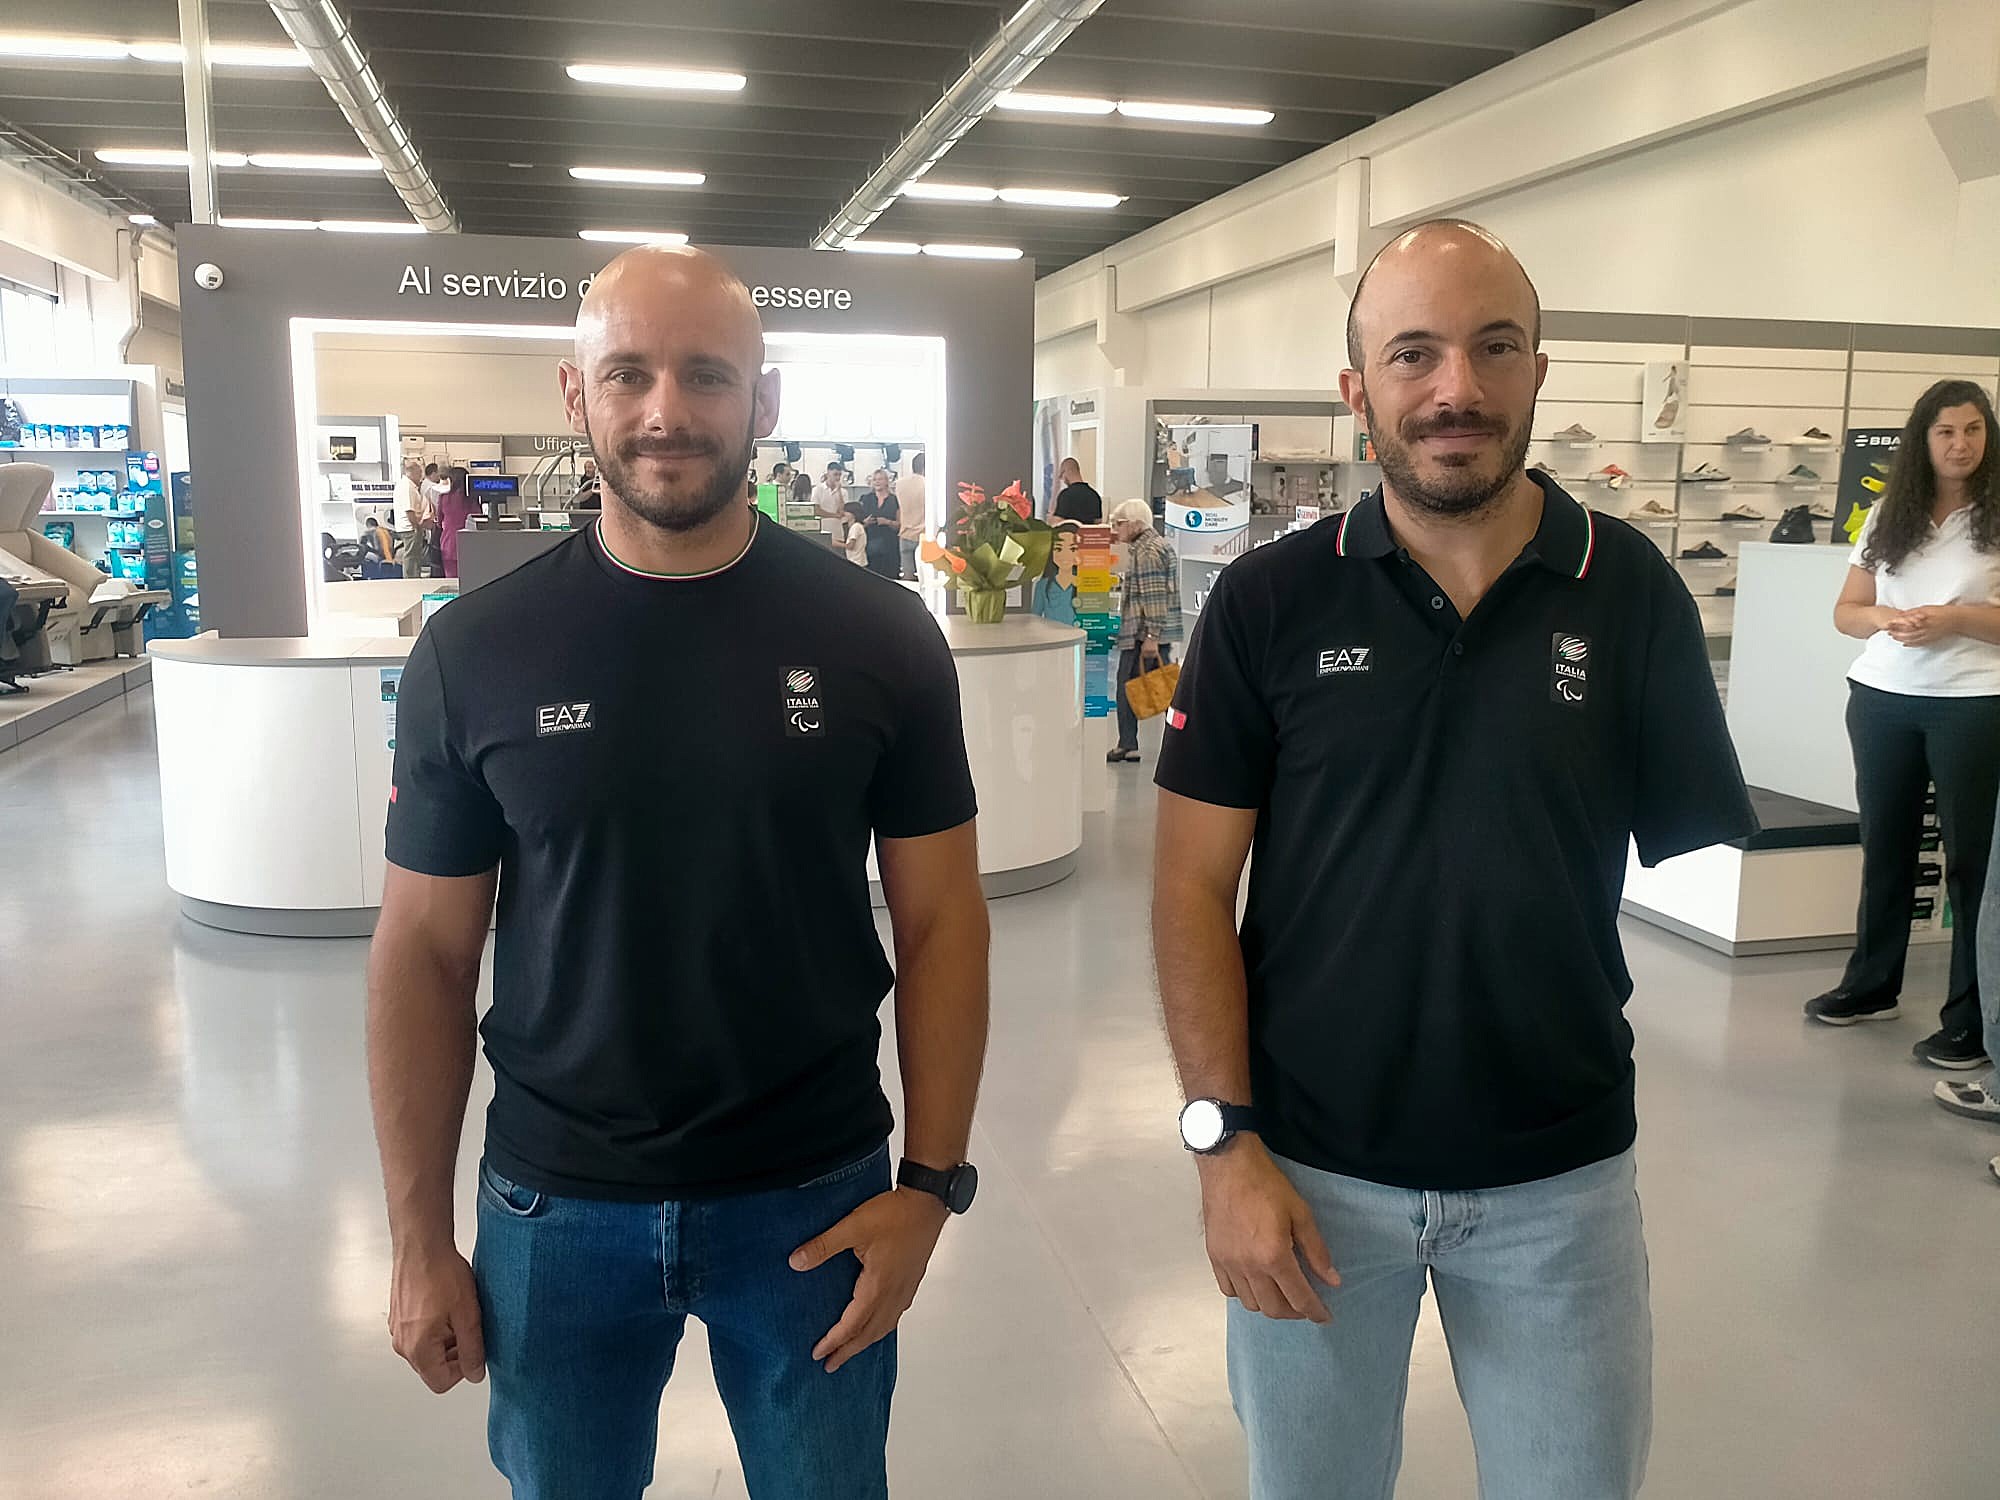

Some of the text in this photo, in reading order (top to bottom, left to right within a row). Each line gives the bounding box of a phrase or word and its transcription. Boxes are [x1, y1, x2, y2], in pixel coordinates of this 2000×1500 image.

[398, 265, 431, 295] Al
[442, 269, 567, 300] servizio
[1319, 647, 1370, 669] EA7
[1555, 663, 1586, 678] ITALIA
[786, 697, 819, 706] ITALIA
[540, 703, 591, 727] EA7
